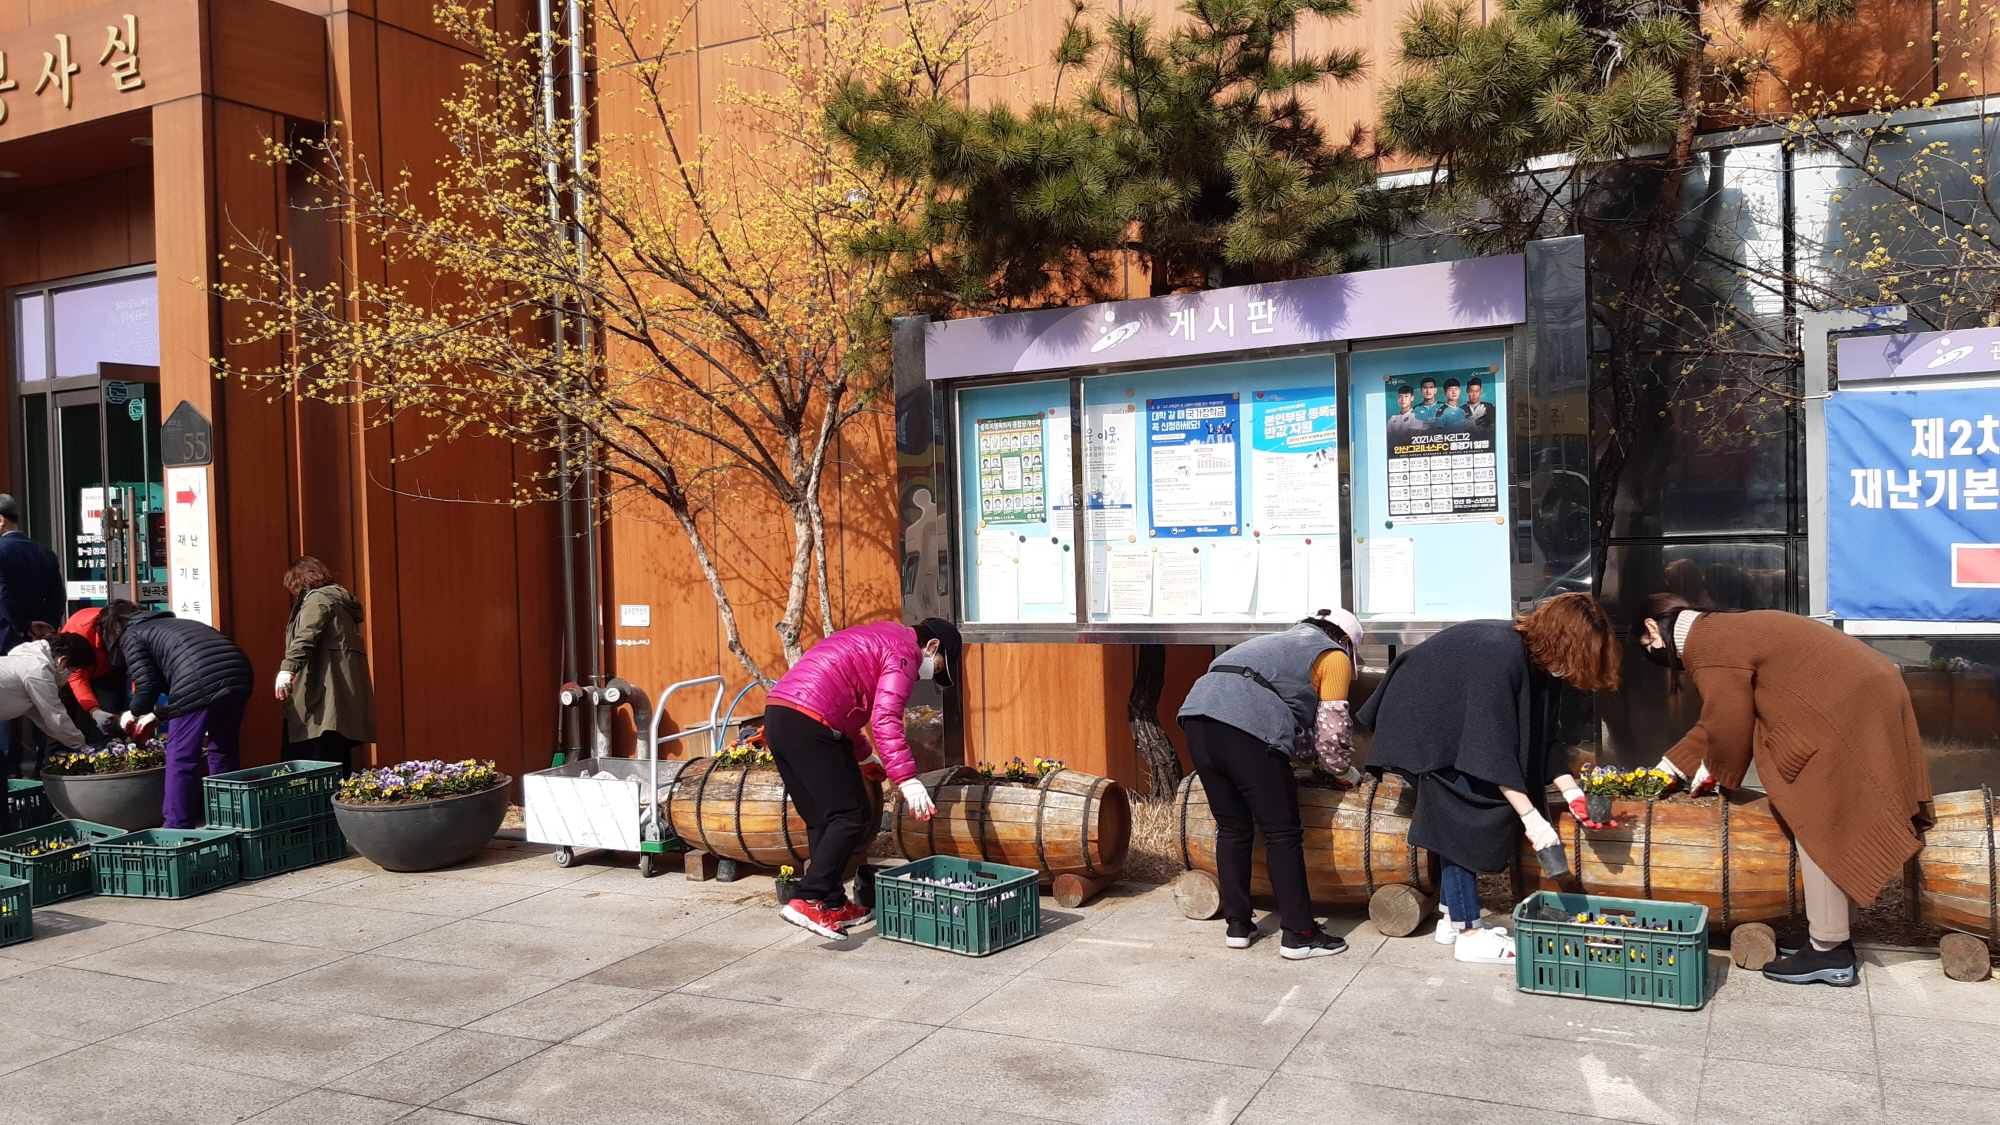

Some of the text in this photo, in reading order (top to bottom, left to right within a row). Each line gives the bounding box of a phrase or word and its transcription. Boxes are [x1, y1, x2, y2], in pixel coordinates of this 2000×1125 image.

[1169, 299, 1277, 342] 게시판
[1152, 410, 1166, 421] 대학
[1168, 410, 1176, 420] 갈
[1187, 407, 1225, 418] 국가장학금
[1264, 409, 1306, 427] 본인부담
[1161, 420, 1200, 432] 신청하세요!
[1289, 420, 1313, 435] 지원
[1098, 426, 1120, 444] 이웃,
[1411, 432, 1471, 445] 2021시즌 K리그2
[183, 432, 207, 461] 55
[1394, 439, 1490, 455] 안산그리너스FC 홈경기 일정
[177, 534, 199, 547] 재난
[78, 547, 92, 556] 월~금
[180, 567, 200, 580] 기본
[80, 584, 97, 594] 원곡동
[181, 601, 201, 614] 소득
